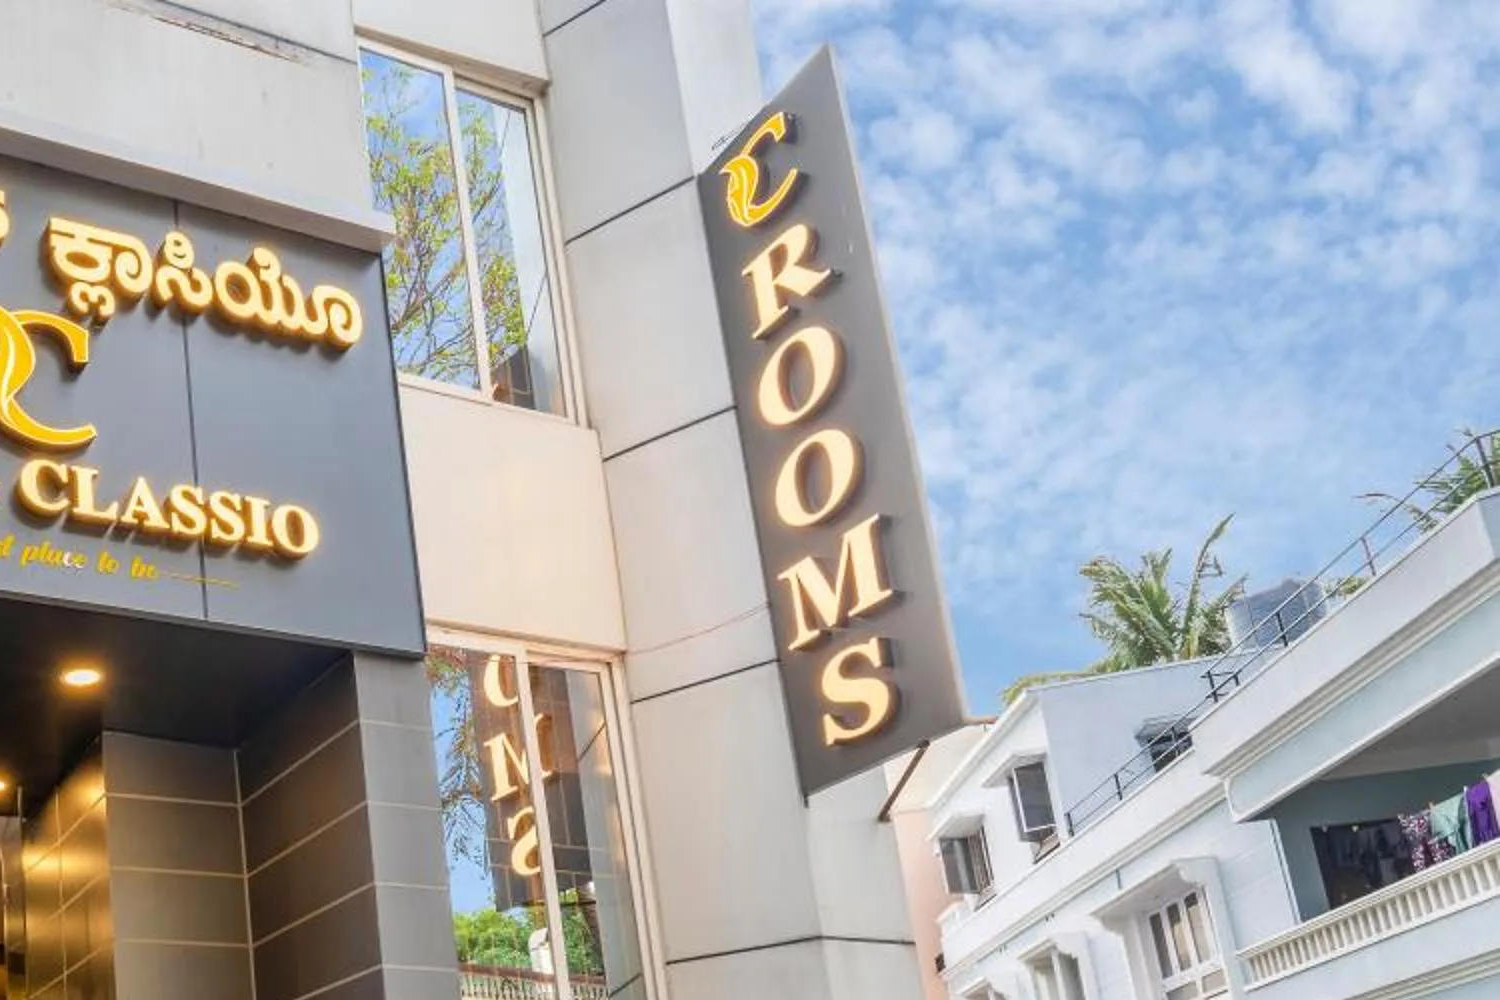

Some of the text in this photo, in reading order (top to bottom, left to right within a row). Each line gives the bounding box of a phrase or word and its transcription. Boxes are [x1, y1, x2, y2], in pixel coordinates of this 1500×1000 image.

[17, 457, 321, 558] CLASSIO
[741, 222, 898, 750] ROOMS
[19, 537, 87, 572] place
[98, 550, 121, 575] to
